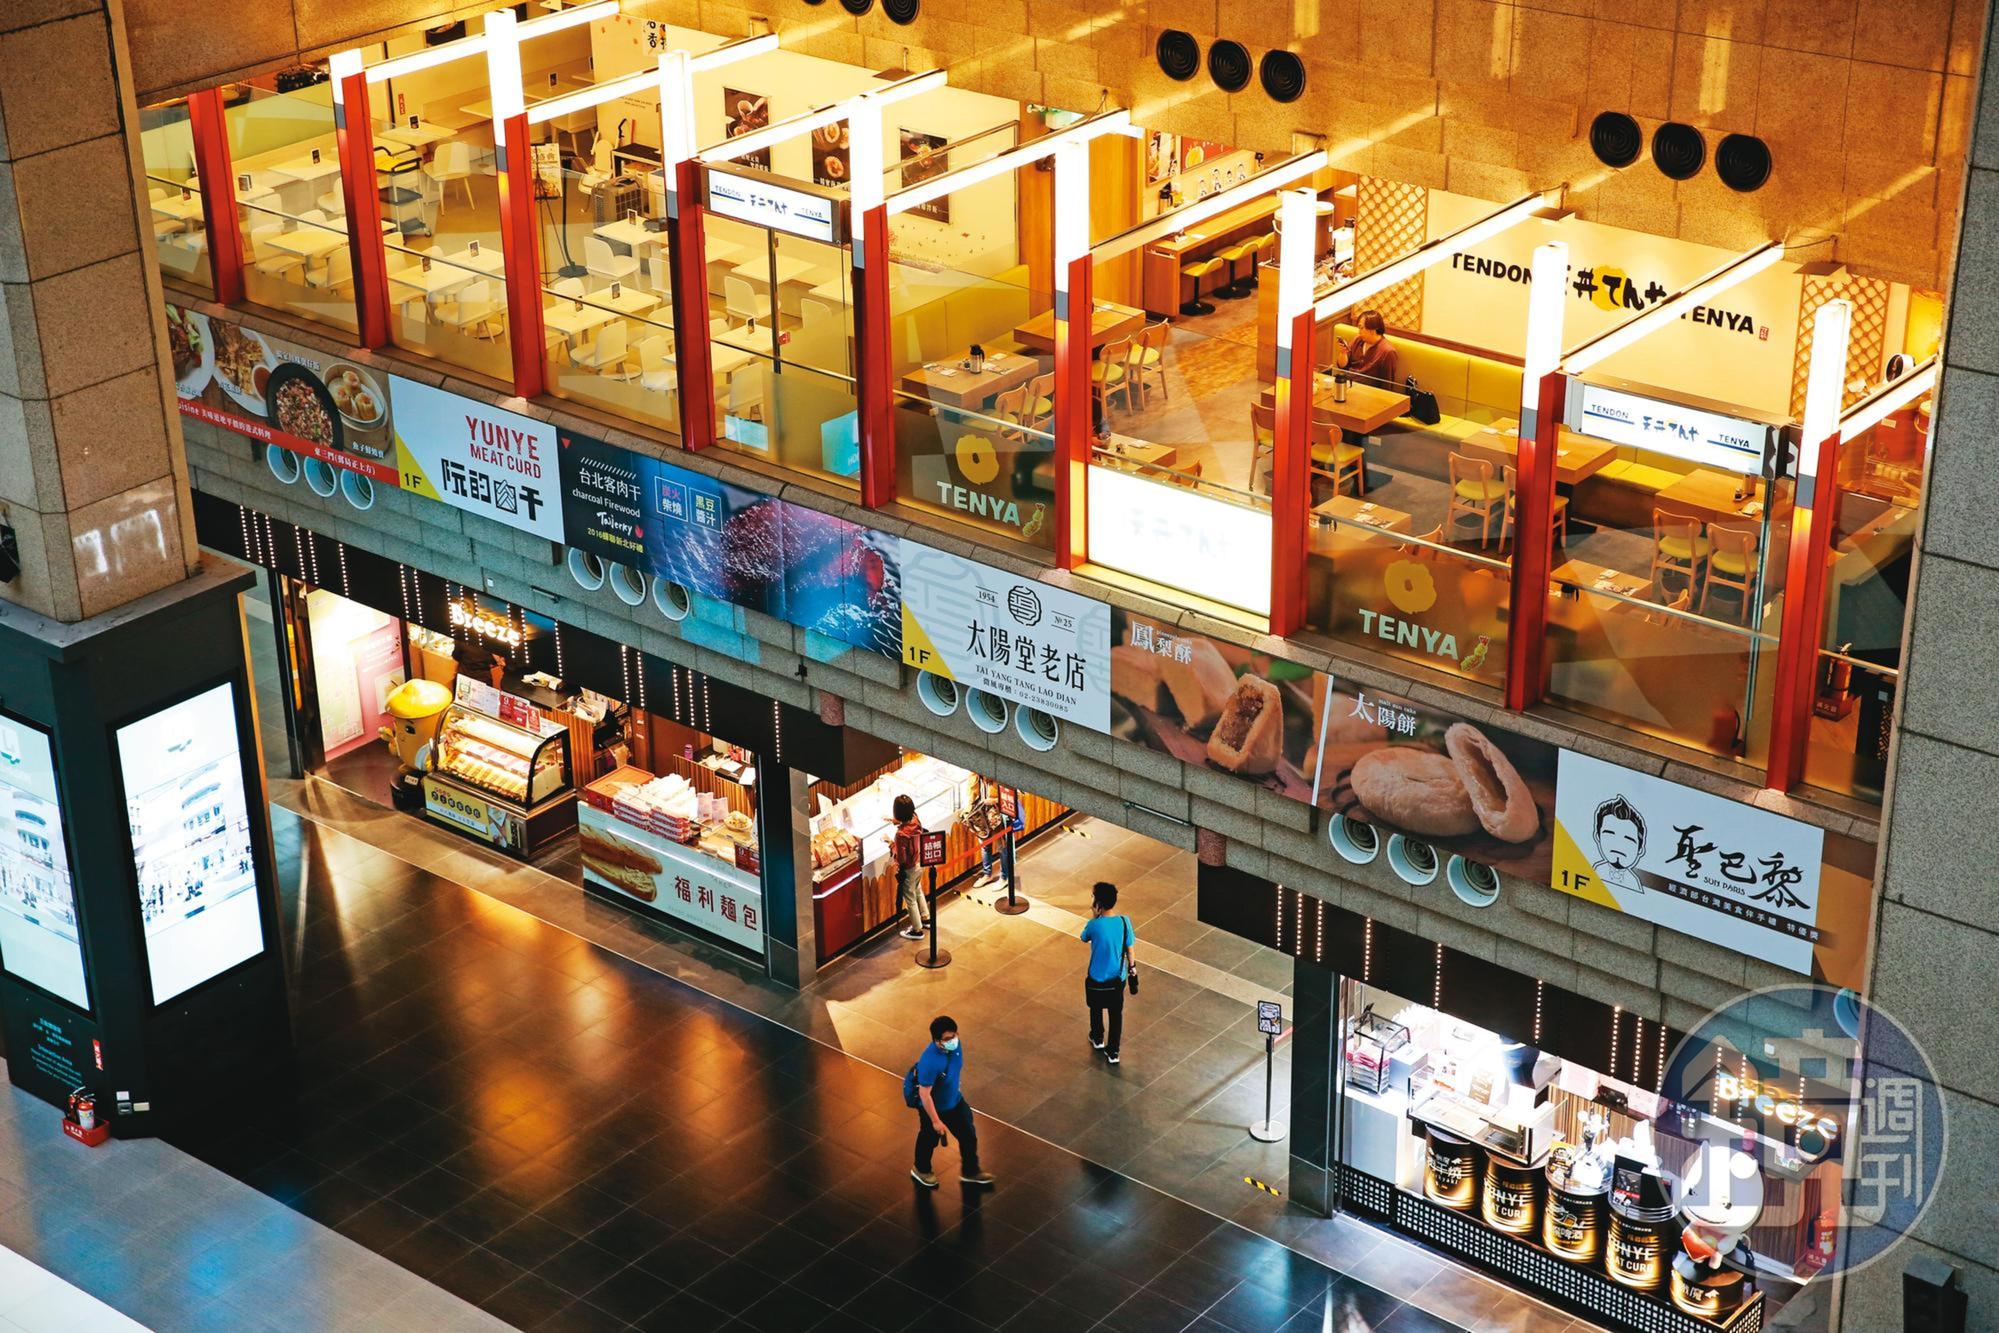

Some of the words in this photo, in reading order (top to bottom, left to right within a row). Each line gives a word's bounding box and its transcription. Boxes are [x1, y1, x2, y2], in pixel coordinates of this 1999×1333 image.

[1565, 264, 1667, 312] 丼てんや
[1591, 404, 1630, 420] TENDON
[465, 415, 540, 461] YUNYE
[1719, 434, 1750, 449] TENYA
[469, 443, 504, 467] MEAT
[507, 455, 542, 479] CURD
[404, 472, 422, 489] 1F
[579, 467, 641, 502] 台北客肉干
[662, 484, 681, 500] 炭火
[572, 487, 603, 507] charcoal
[604, 498, 641, 518] Firewood
[662, 498, 683, 516] 柴燒
[695, 494, 716, 513] 黑豆
[695, 509, 716, 527] 醬汁
[936, 481, 1021, 527] TENYA
[978, 590, 996, 603] 1954
[449, 601, 521, 647] Breeze
[1358, 608, 1459, 661] TENYA
[909, 646, 931, 665] 1F
[966, 619, 1087, 692] 太陽堂老店
[1130, 620, 1193, 665] 鳳梨酥
[975, 664, 990, 676] TAI
[990, 669, 1013, 685] YANG
[1014, 677, 1036, 693] TANG
[1038, 685, 1054, 699] LAO
[1056, 692, 1077, 706] DIAN
[1347, 691, 1417, 737] 太陽餅
[924, 849, 942, 860] 出口
[1665, 824, 1811, 910] 聖巴黎
[1559, 869, 1590, 892] 1F
[1703, 876, 1721, 888] SUN
[1722, 882, 1746, 896] PARIS
[674, 875, 758, 931] 福利麵包
[1718, 1072, 1838, 1140] Breeze
